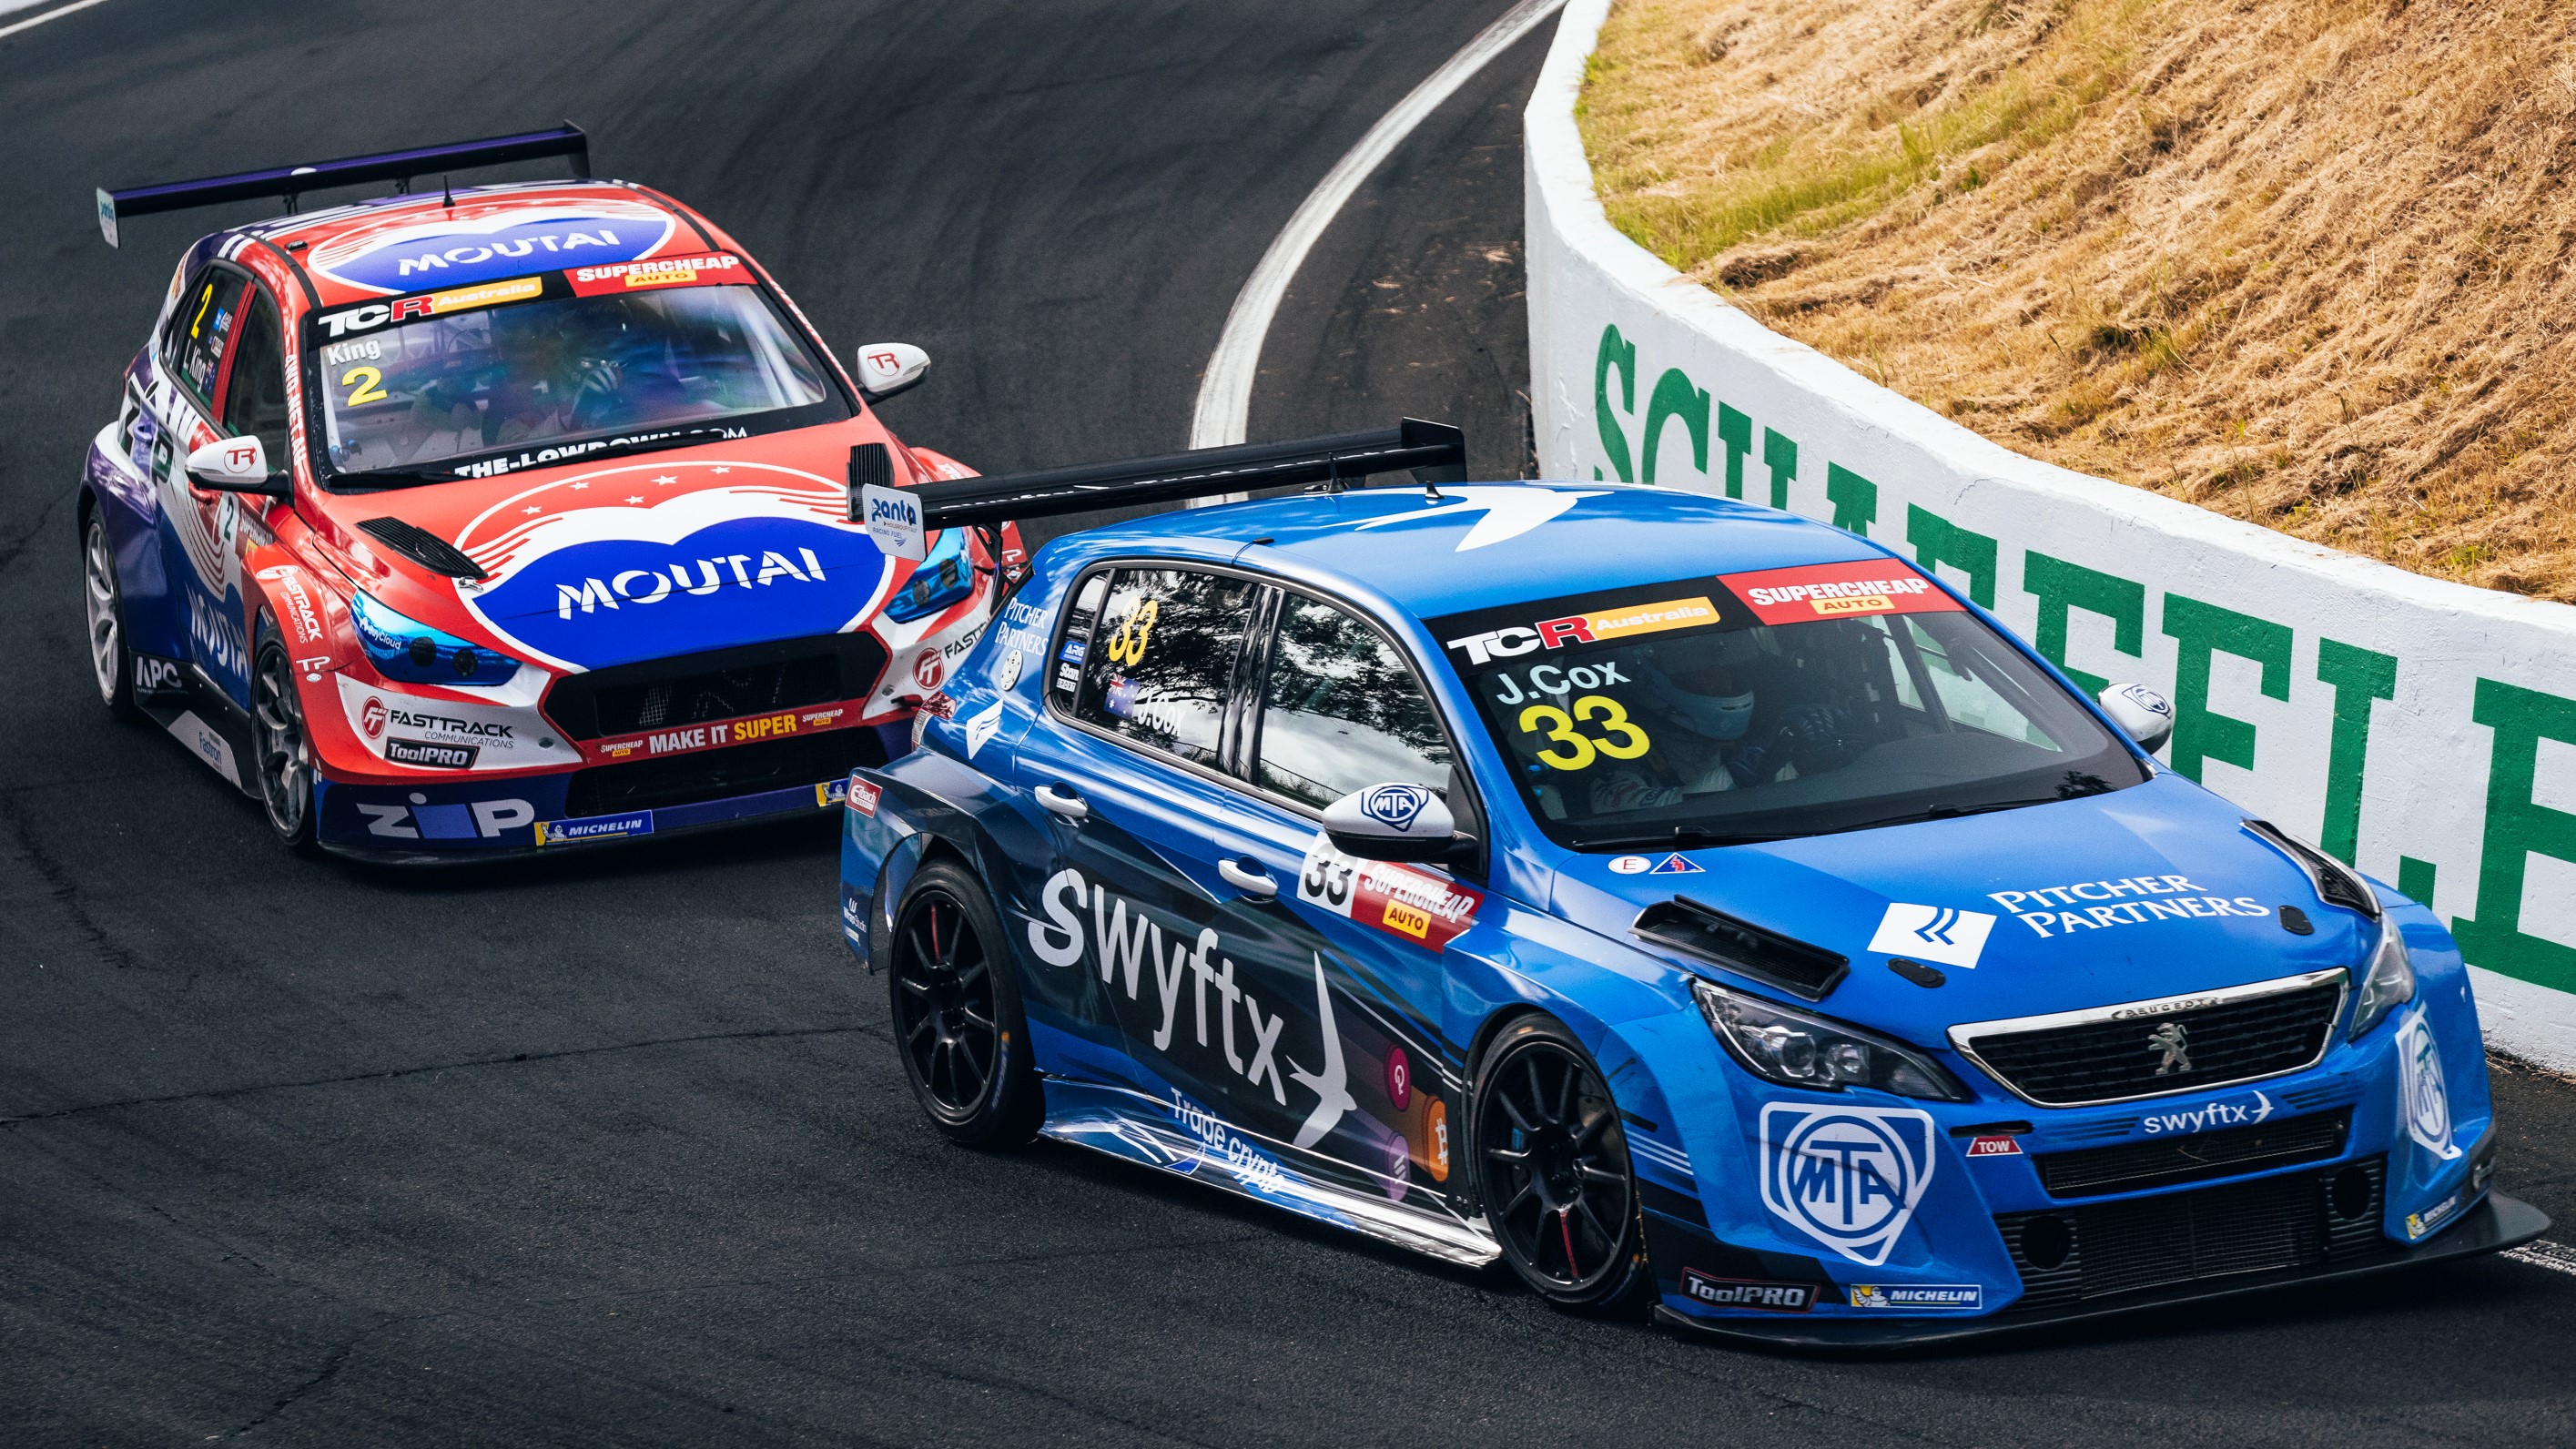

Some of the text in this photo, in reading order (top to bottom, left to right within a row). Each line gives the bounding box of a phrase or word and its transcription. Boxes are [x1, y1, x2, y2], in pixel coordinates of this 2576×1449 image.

[398, 229, 622, 276] MOUTAI
[577, 255, 739, 282] SUPERCHEAP
[633, 272, 688, 285] AUTO
[190, 283, 213, 339] 2
[319, 283, 535, 338] TCR Australia
[189, 344, 207, 393] King
[327, 339, 380, 367] King
[341, 366, 388, 407] 2
[224, 495, 231, 542] 2
[555, 546, 827, 621] MOUTAI
[1747, 577, 1930, 608] SUPERCHEAP
[278, 567, 324, 643] FASTTRACK
[1003, 597, 1049, 629] PITCHER
[1823, 599, 1883, 613] AUTO
[994, 621, 1050, 657] PARTNERS
[1108, 595, 1159, 667] 33
[1446, 604, 1709, 666] TCR Australia
[1065, 644, 1085, 657] ARG
[136, 656, 182, 688] APC
[1057, 679, 1076, 692] SPORT
[1496, 661, 1632, 705] J.Cox
[390, 710, 513, 739] FASTTRACK
[802, 709, 844, 723] SUPERCHEAP
[1138, 688, 1187, 737] J.Cox
[424, 730, 514, 749] COMMUNICATIONS
[601, 739, 644, 754] SUPERCHEAP
[649, 714, 797, 755] MAKE IT SUPER
[1518, 694, 1652, 771] 33
[390, 743, 469, 765] ToolPRO
[1374, 792, 1415, 817] MTA
[568, 819, 643, 836] MICHELIN
[1304, 842, 1359, 907] 33
[1623, 859, 1638, 870] E
[1364, 863, 1475, 924] SUPERCHEAP
[1986, 875, 2208, 914] PITCHER
[1388, 907, 1424, 931] AUTO
[2016, 897, 2271, 938] PARTNERS
[2125, 998, 2206, 1019] PEUGEOT
[1171, 1087, 1226, 1150] Trade
[2144, 1101, 2249, 1134] swyftx
[1977, 1140, 2011, 1154] TOW
[1793, 1140, 1902, 1225] MTA
[1687, 1274, 1806, 1307] ToolPRO
[1890, 1290, 1978, 1302] MICHELIN
